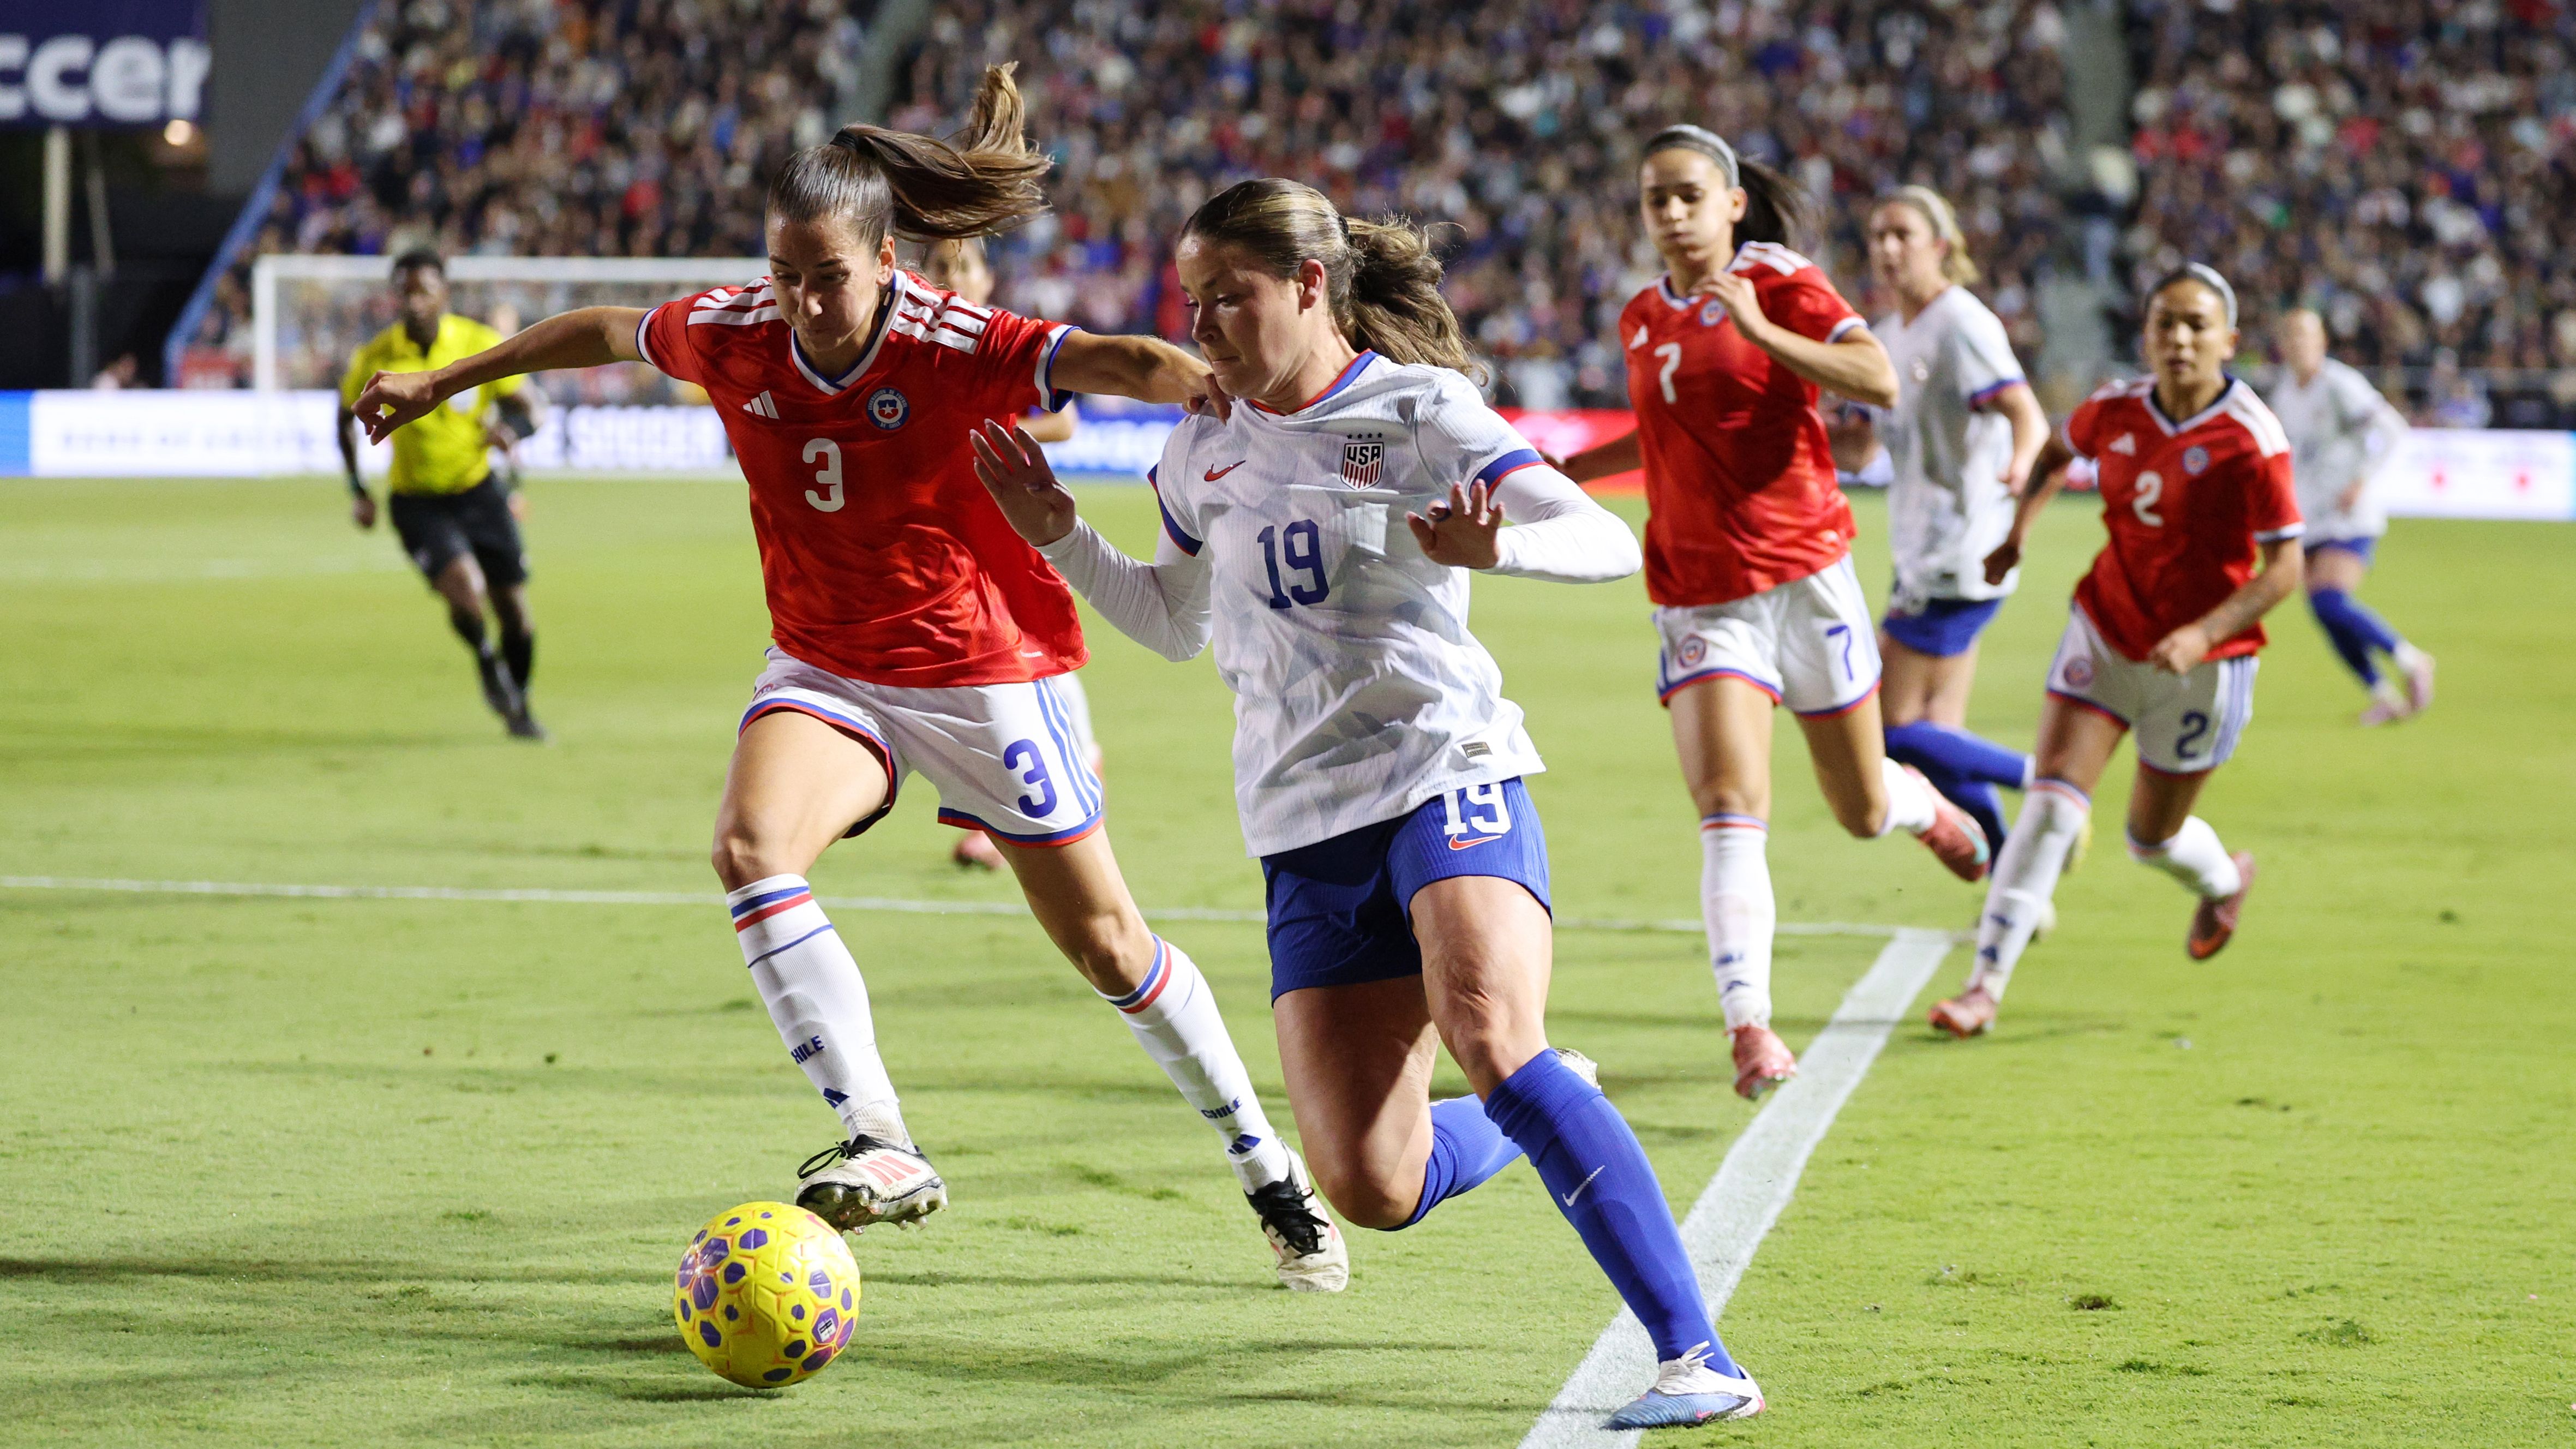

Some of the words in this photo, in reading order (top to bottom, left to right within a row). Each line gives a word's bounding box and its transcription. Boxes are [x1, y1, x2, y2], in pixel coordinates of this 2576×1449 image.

[1655, 342, 1681, 404] 7
[802, 438, 845, 512] 3
[1346, 446, 1381, 465] USA
[2132, 470, 2164, 528] 2
[1257, 519, 1330, 609] 19
[1825, 624, 1854, 682] 7
[2174, 710, 2208, 760] 2
[1003, 739, 1057, 818] 3
[1443, 782, 1512, 835] 19
[790, 1035, 825, 1065] HILE
[1201, 1095, 1243, 1118] CHILE
